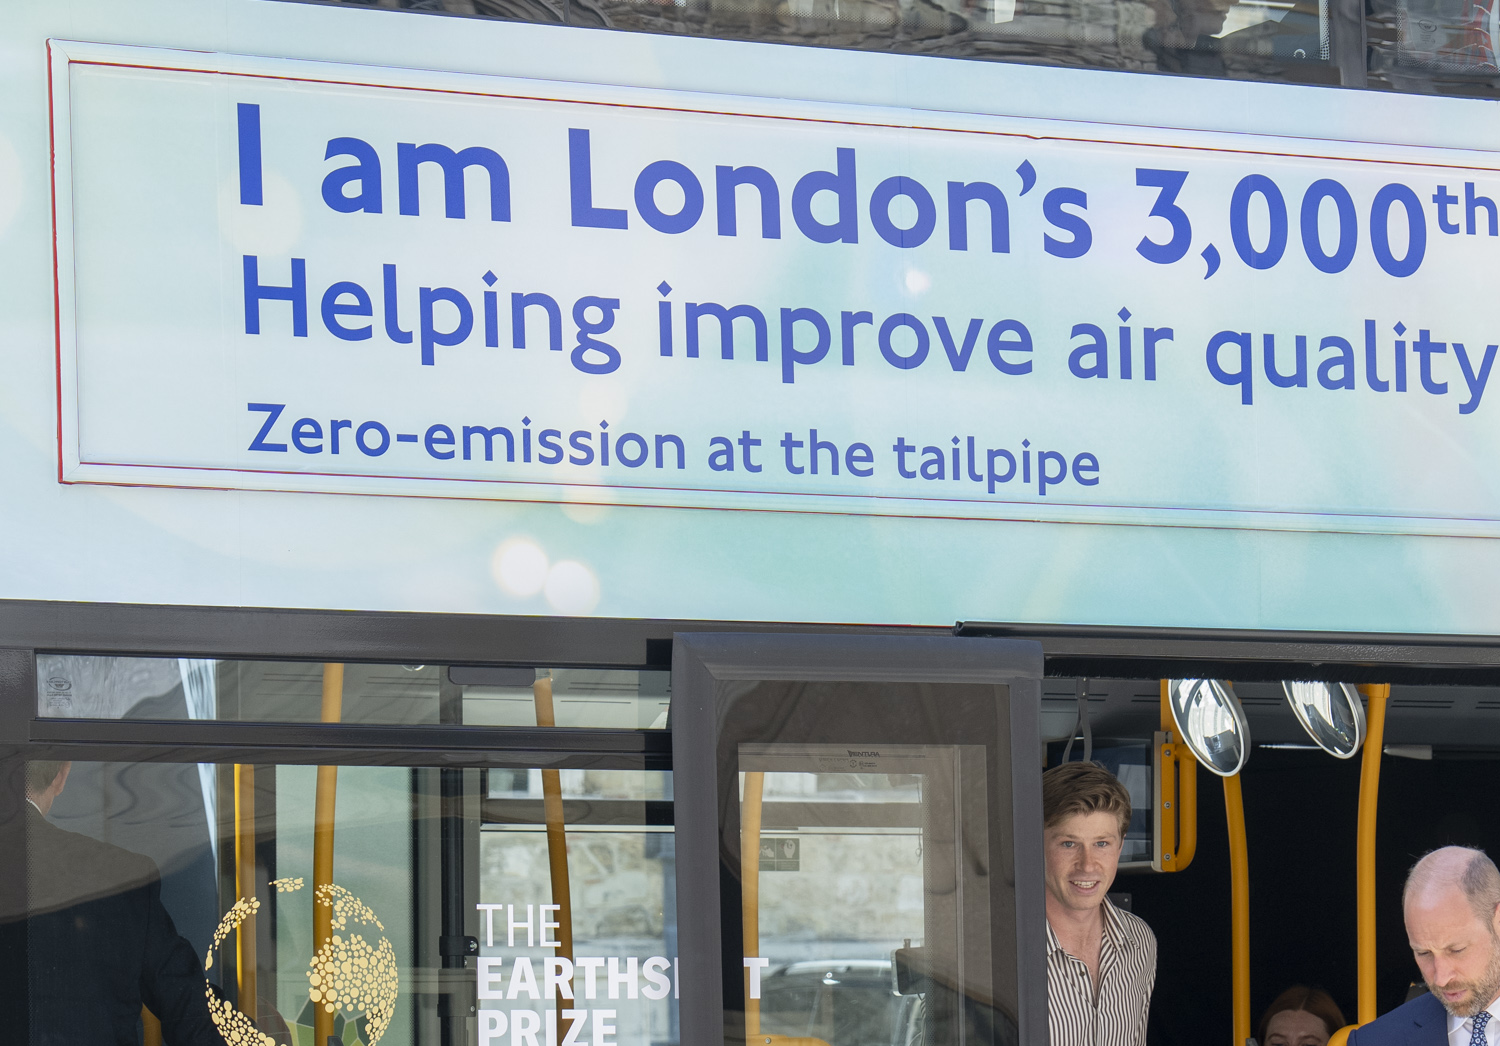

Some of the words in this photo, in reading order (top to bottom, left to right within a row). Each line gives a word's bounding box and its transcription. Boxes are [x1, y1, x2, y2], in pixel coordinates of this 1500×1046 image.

[236, 102, 264, 207] I
[321, 136, 512, 223] am
[569, 128, 1093, 260] London's
[242, 254, 622, 375] Helping
[656, 281, 1033, 384] improve
[1068, 307, 1174, 382] air
[1206, 319, 1499, 415] quality
[248, 402, 685, 470] Zero-emission
[707, 429, 763, 475] at
[779, 428, 875, 479] the
[892, 436, 1101, 497] tailpipe
[476, 903, 562, 948] THE
